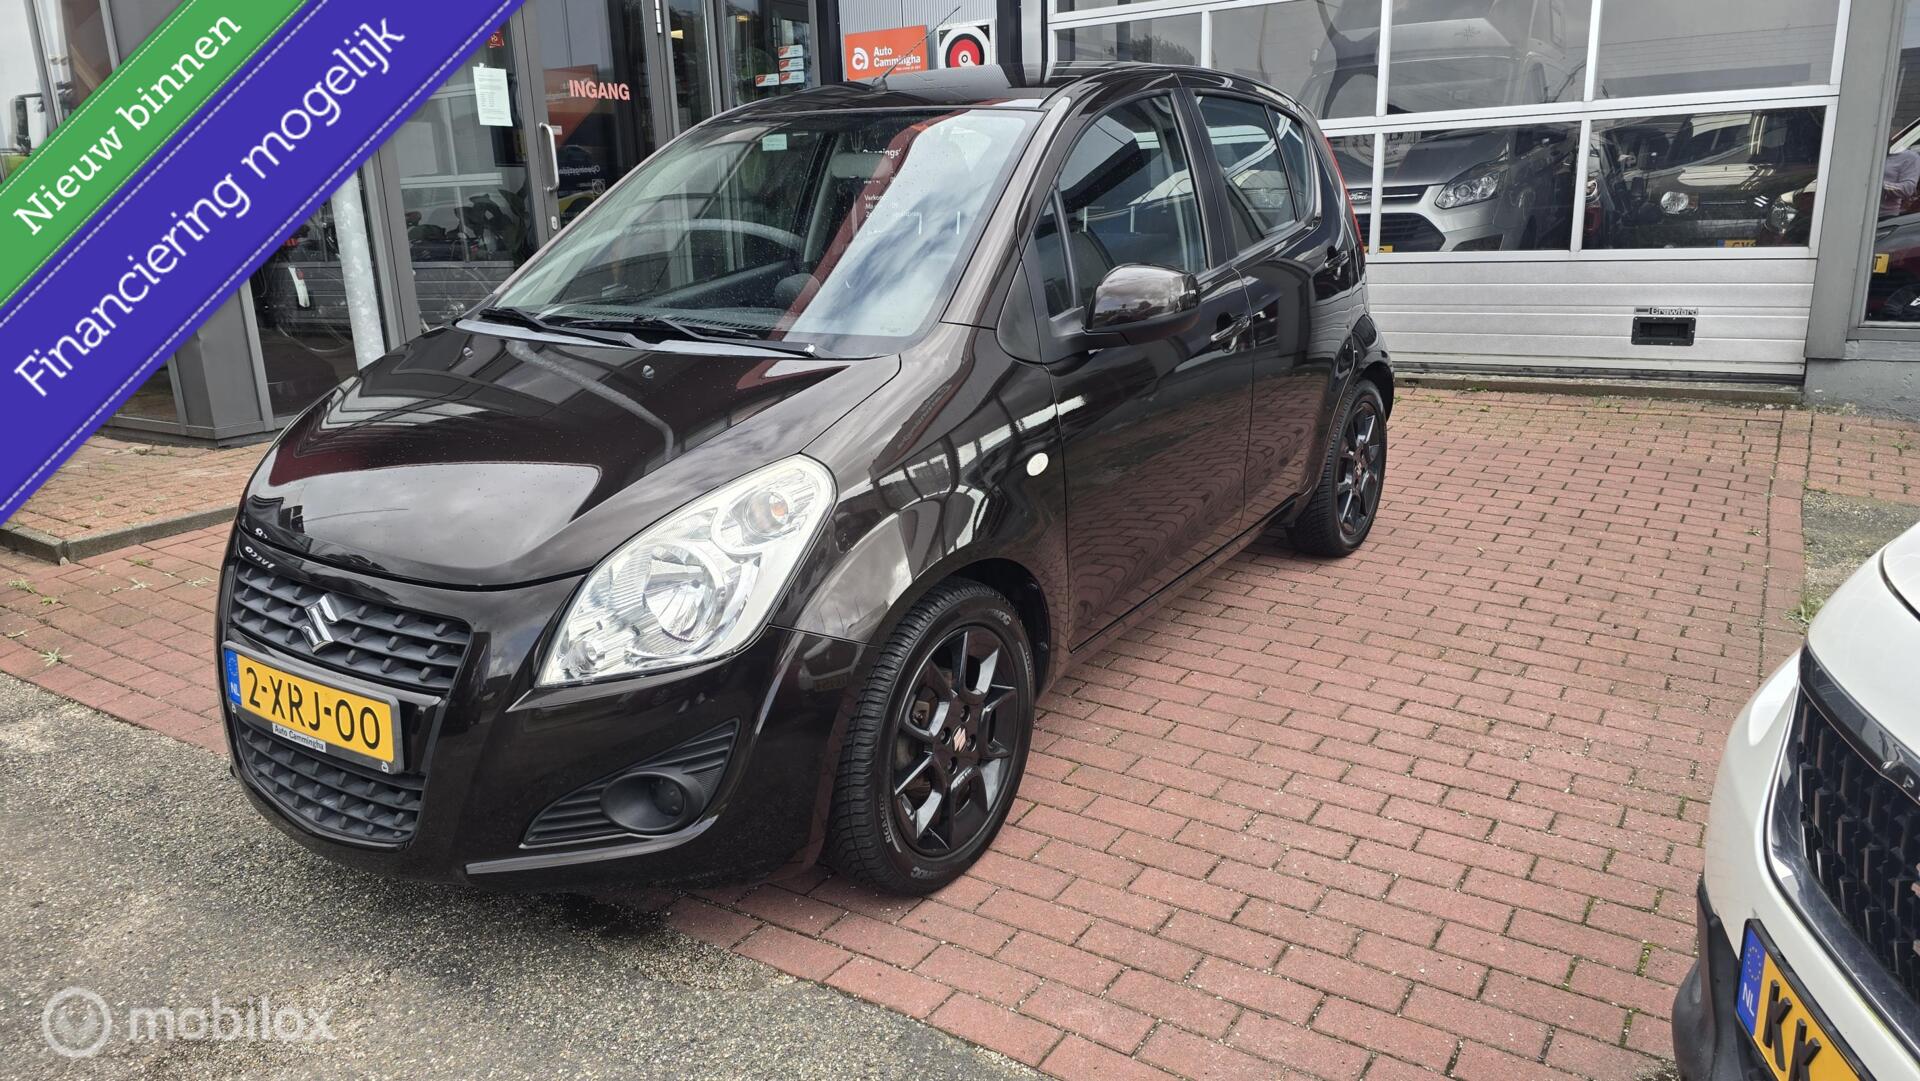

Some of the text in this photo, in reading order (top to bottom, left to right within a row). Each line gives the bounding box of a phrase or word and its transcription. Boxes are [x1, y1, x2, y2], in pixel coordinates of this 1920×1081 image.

[873, 46, 893, 57] Auto
[873, 54, 921, 68] Cammingha
[569, 79, 631, 100] INGANG
[230, 681, 241, 697] NL
[246, 666, 381, 750] 2-XRJ-00
[274, 725, 325, 751] Auto Cammingha
[1742, 982, 1755, 1017] NL
